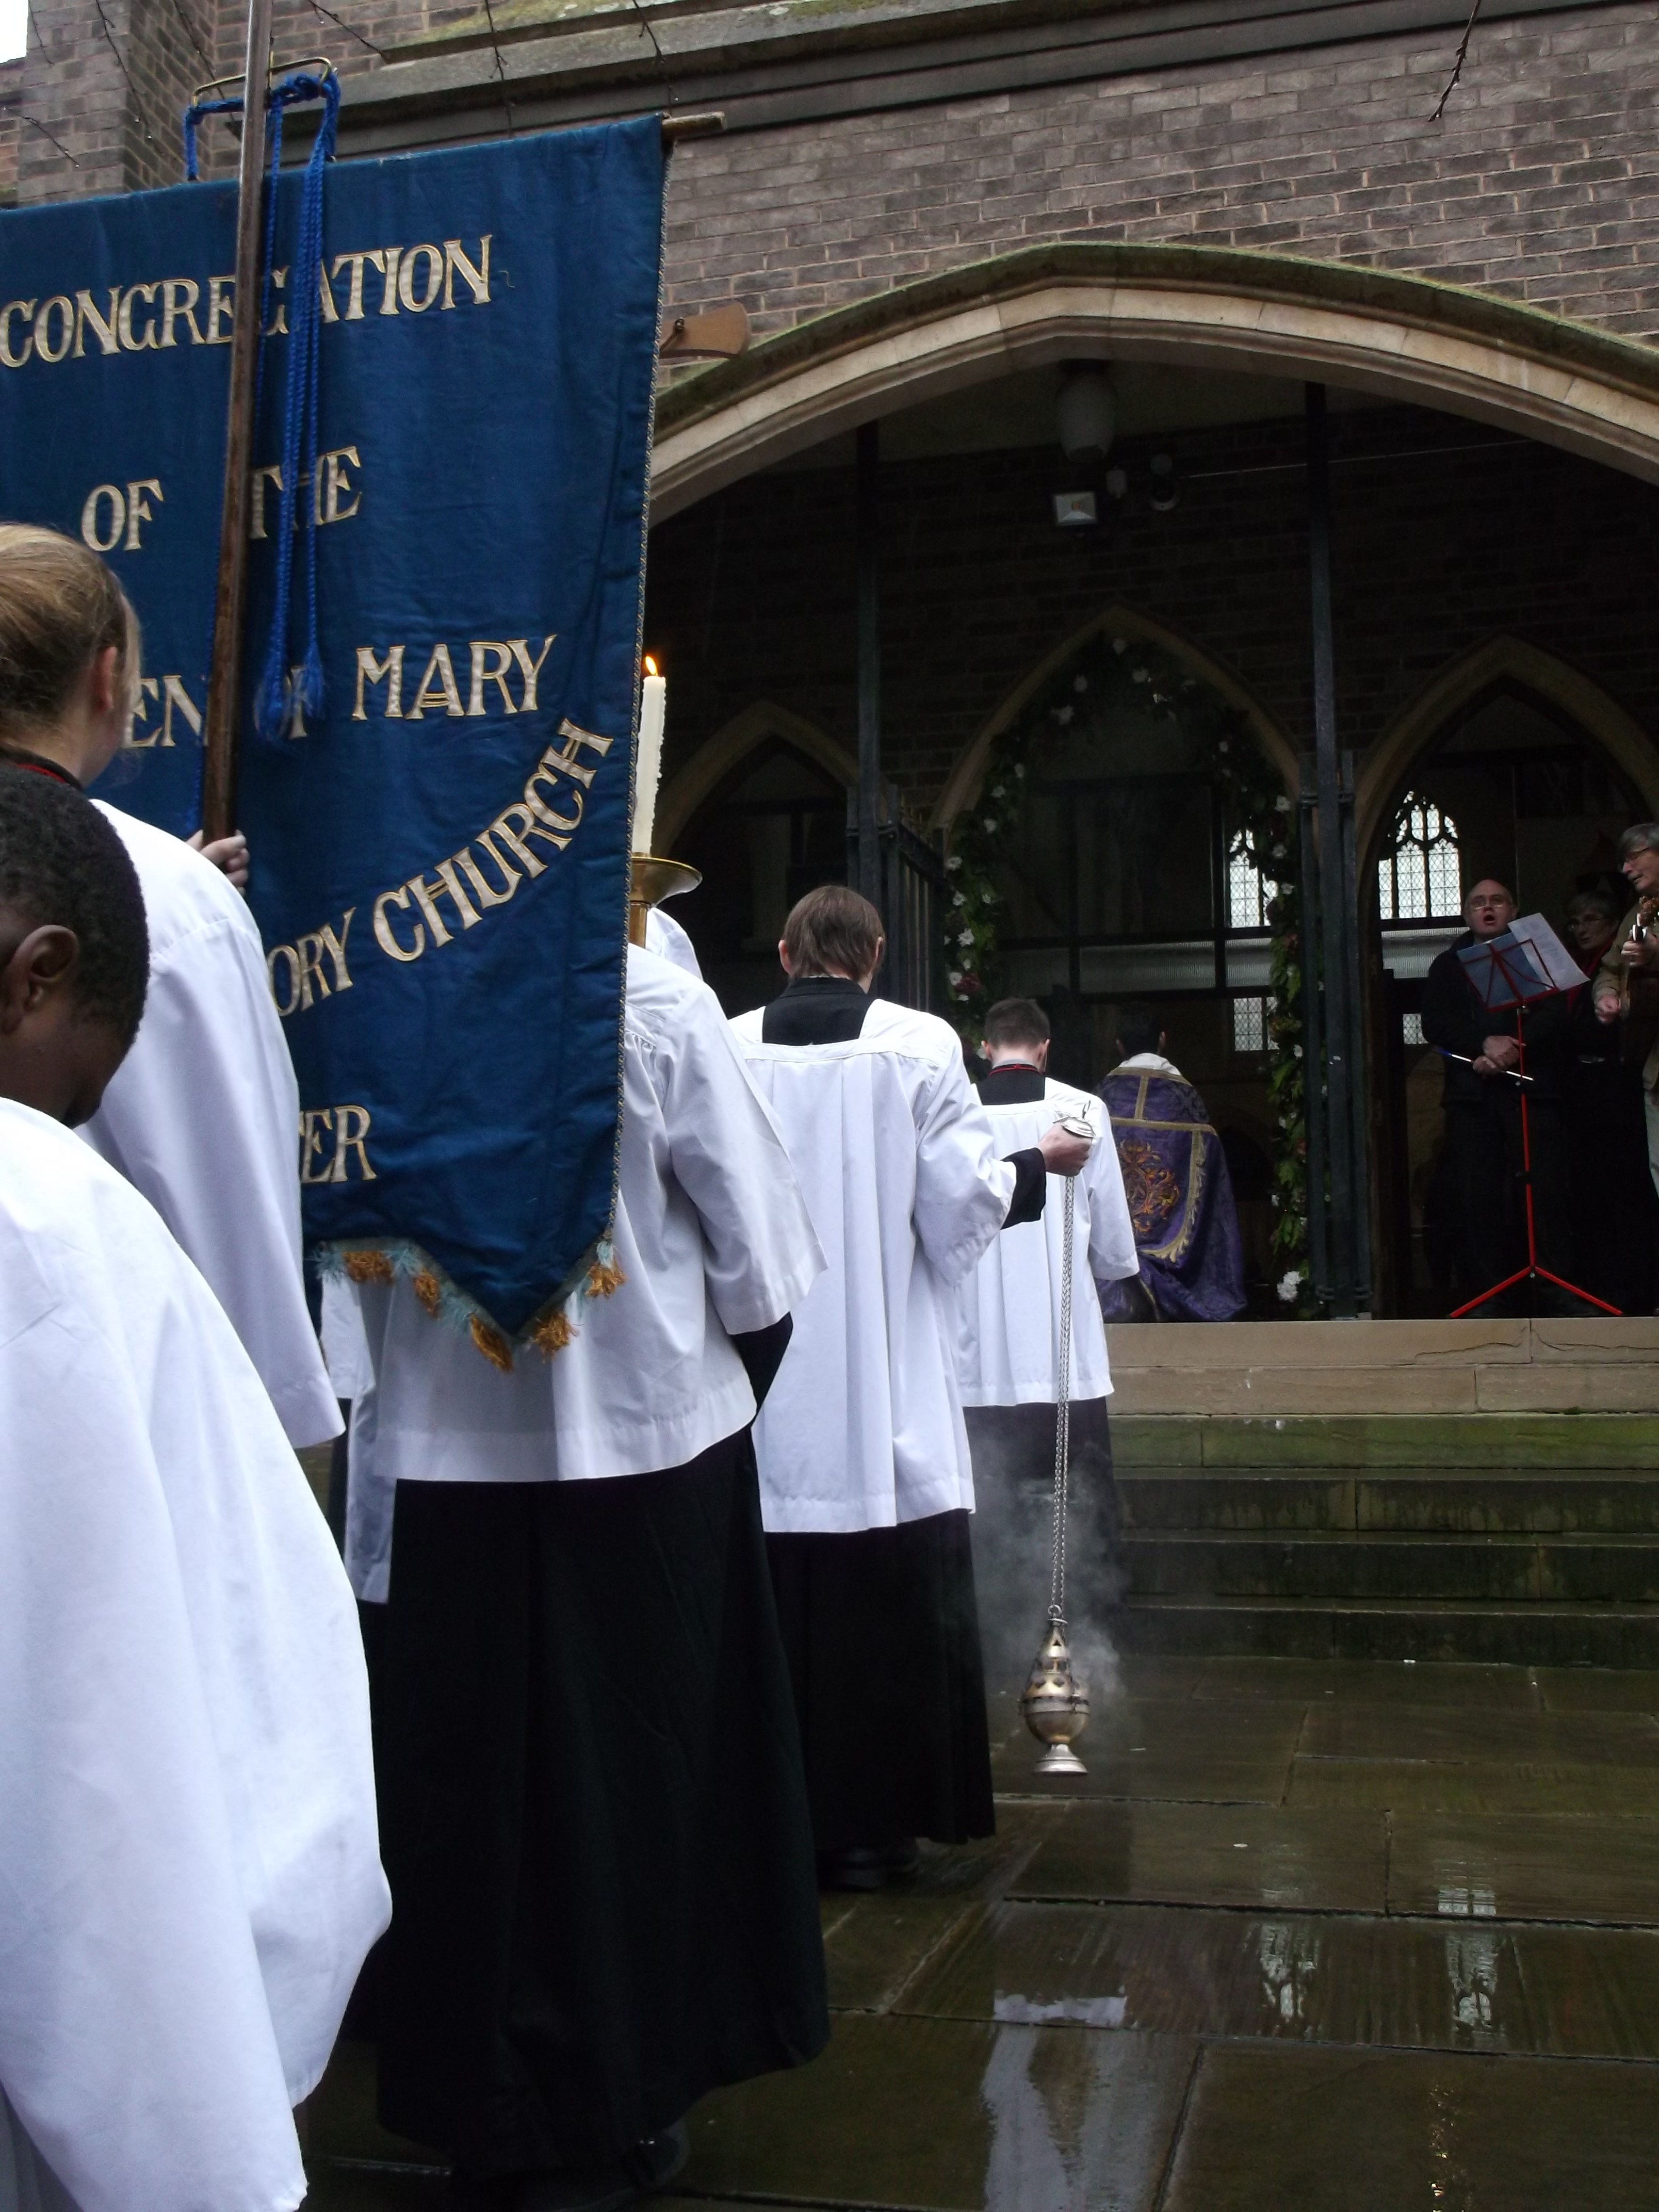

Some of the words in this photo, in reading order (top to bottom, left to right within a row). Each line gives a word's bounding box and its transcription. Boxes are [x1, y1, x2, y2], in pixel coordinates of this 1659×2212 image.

[81, 479, 164, 551] OF
[351, 633, 558, 720] MARY
[372, 718, 614, 962] CHURCH
